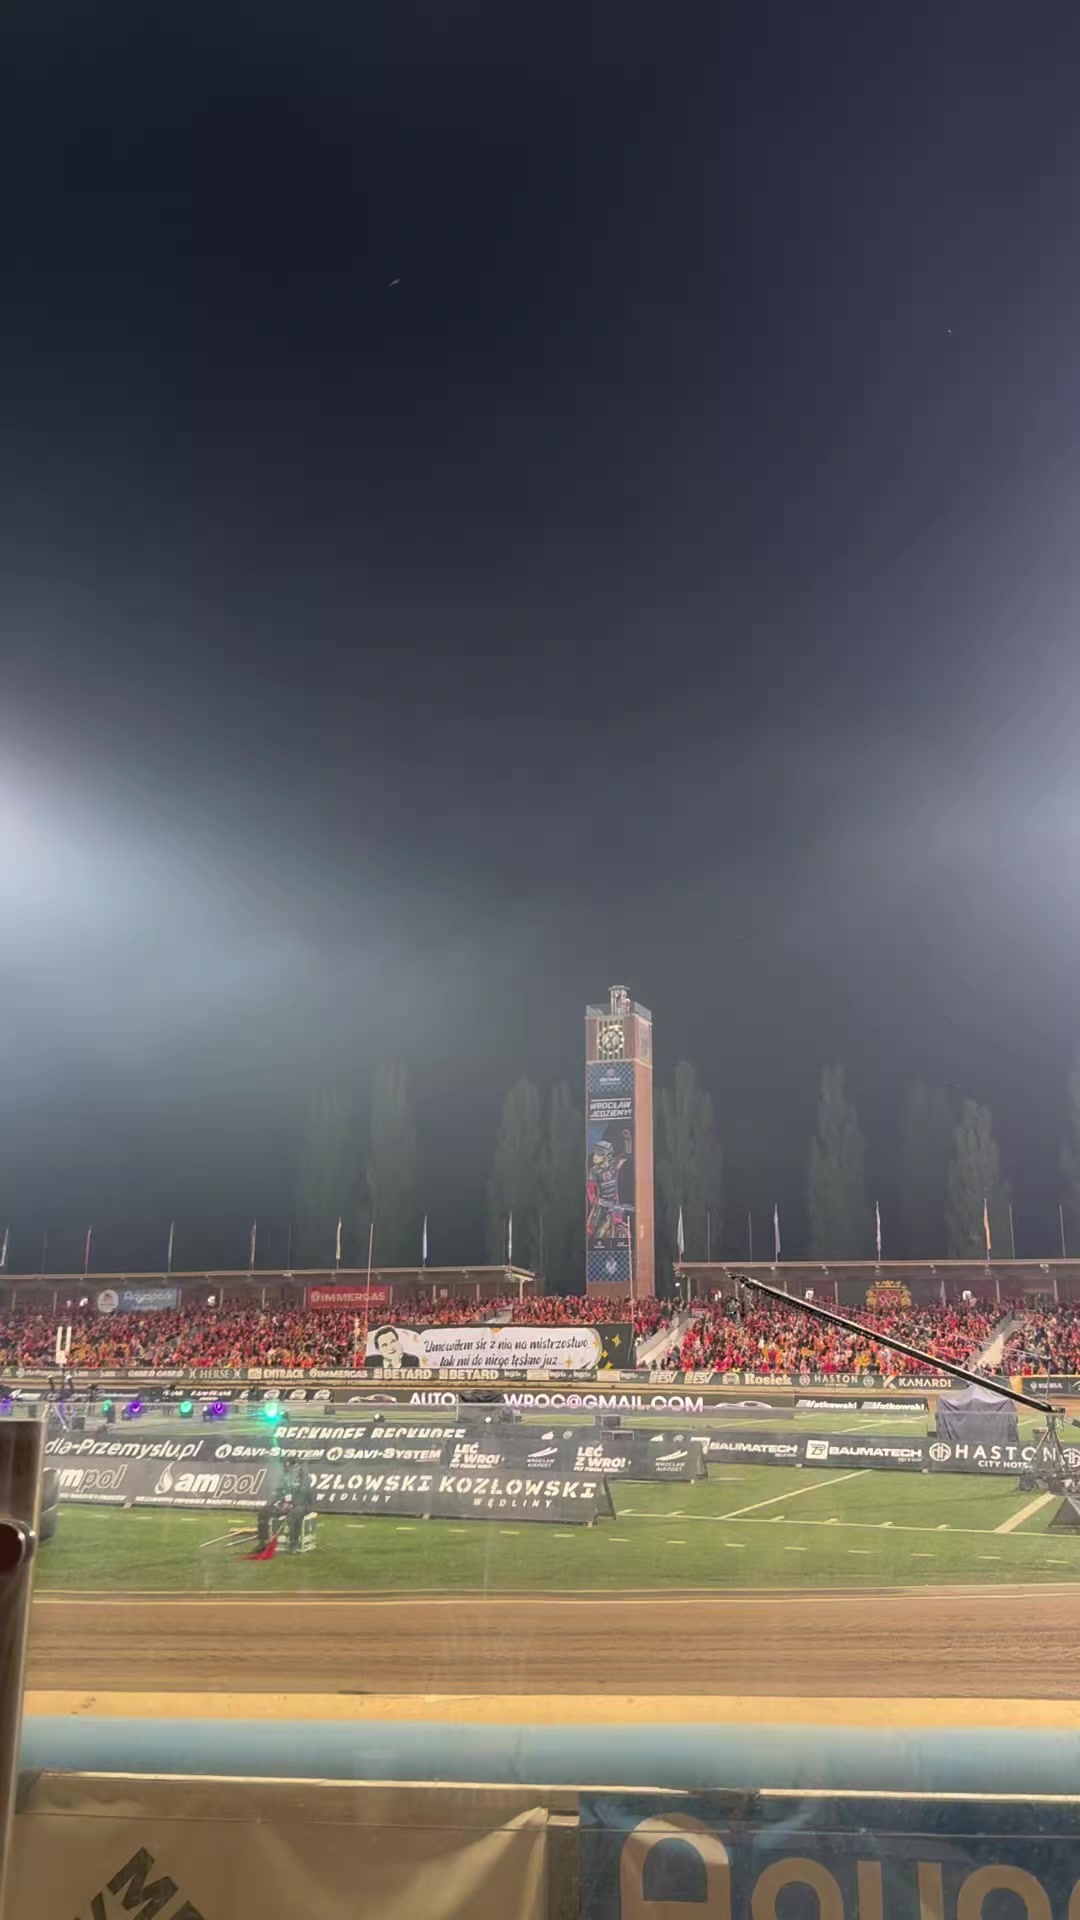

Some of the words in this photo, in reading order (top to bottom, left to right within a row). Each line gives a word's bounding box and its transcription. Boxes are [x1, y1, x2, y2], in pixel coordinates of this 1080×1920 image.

[384, 1369, 432, 1379] BETARD
[449, 1369, 499, 1380] BETARD
[814, 1374, 858, 1383] HASTON
[710, 1441, 798, 1453] BAUMATECH
[828, 1446, 922, 1457] BAUMATECH
[451, 1454, 461, 1463] Z
[575, 1457, 586, 1466] Z
[978, 1460, 1001, 1468] CITY
[174, 1468, 267, 1498] ampol
[438, 1475, 597, 1499] KOZŁOWSKI
